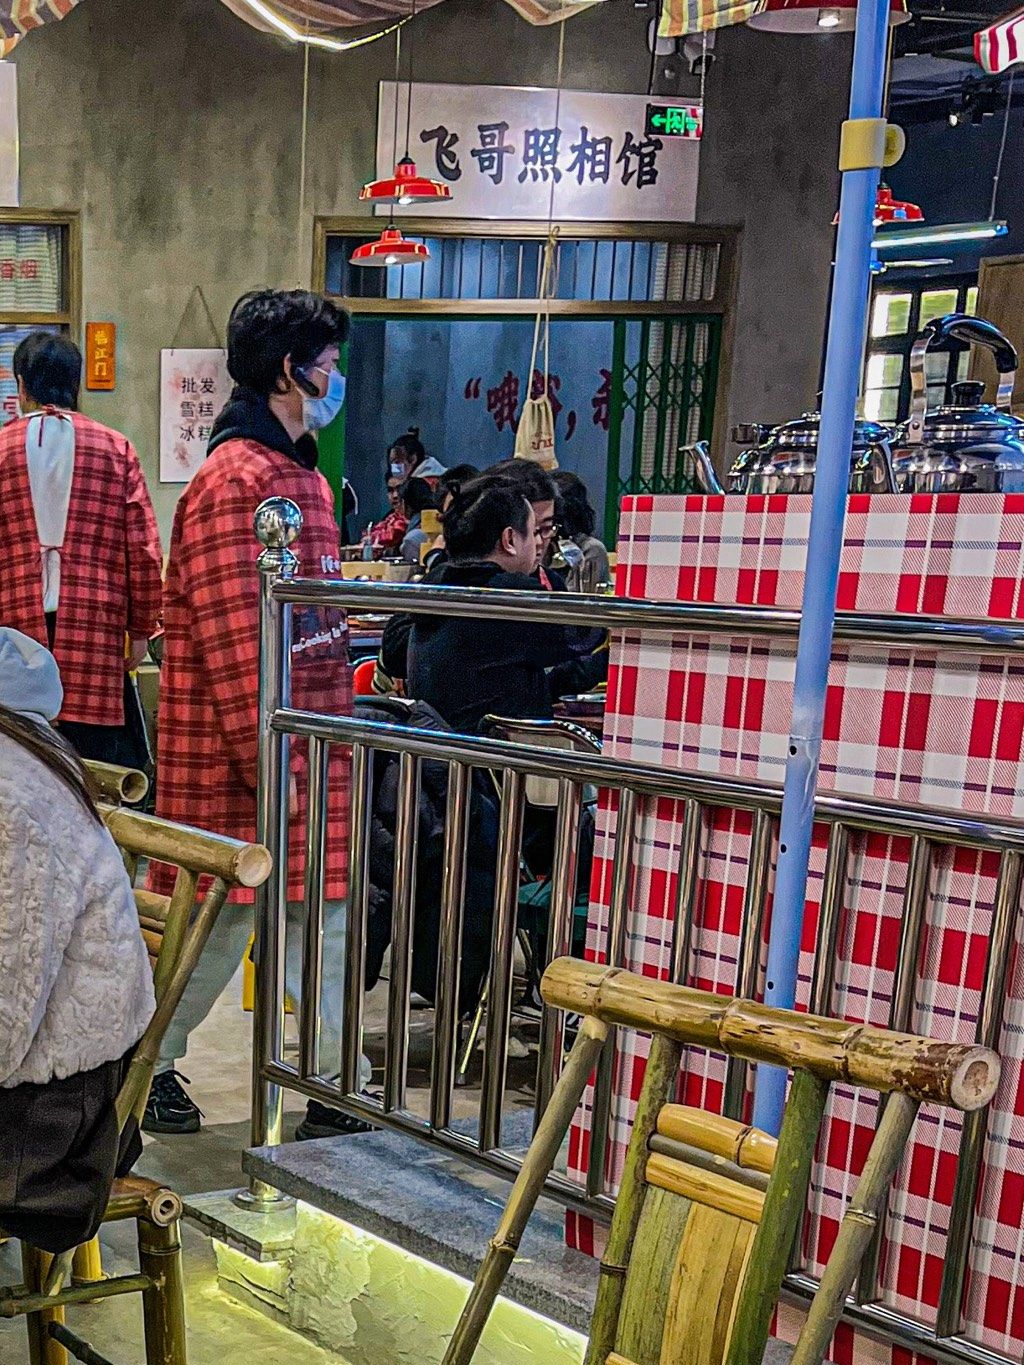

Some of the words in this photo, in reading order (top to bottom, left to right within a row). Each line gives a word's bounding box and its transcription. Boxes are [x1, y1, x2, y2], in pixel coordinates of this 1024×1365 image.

[419, 120, 664, 190] 飞哥照相馆
[181, 376, 216, 395] 批发
[179, 400, 215, 419] 雪糕
